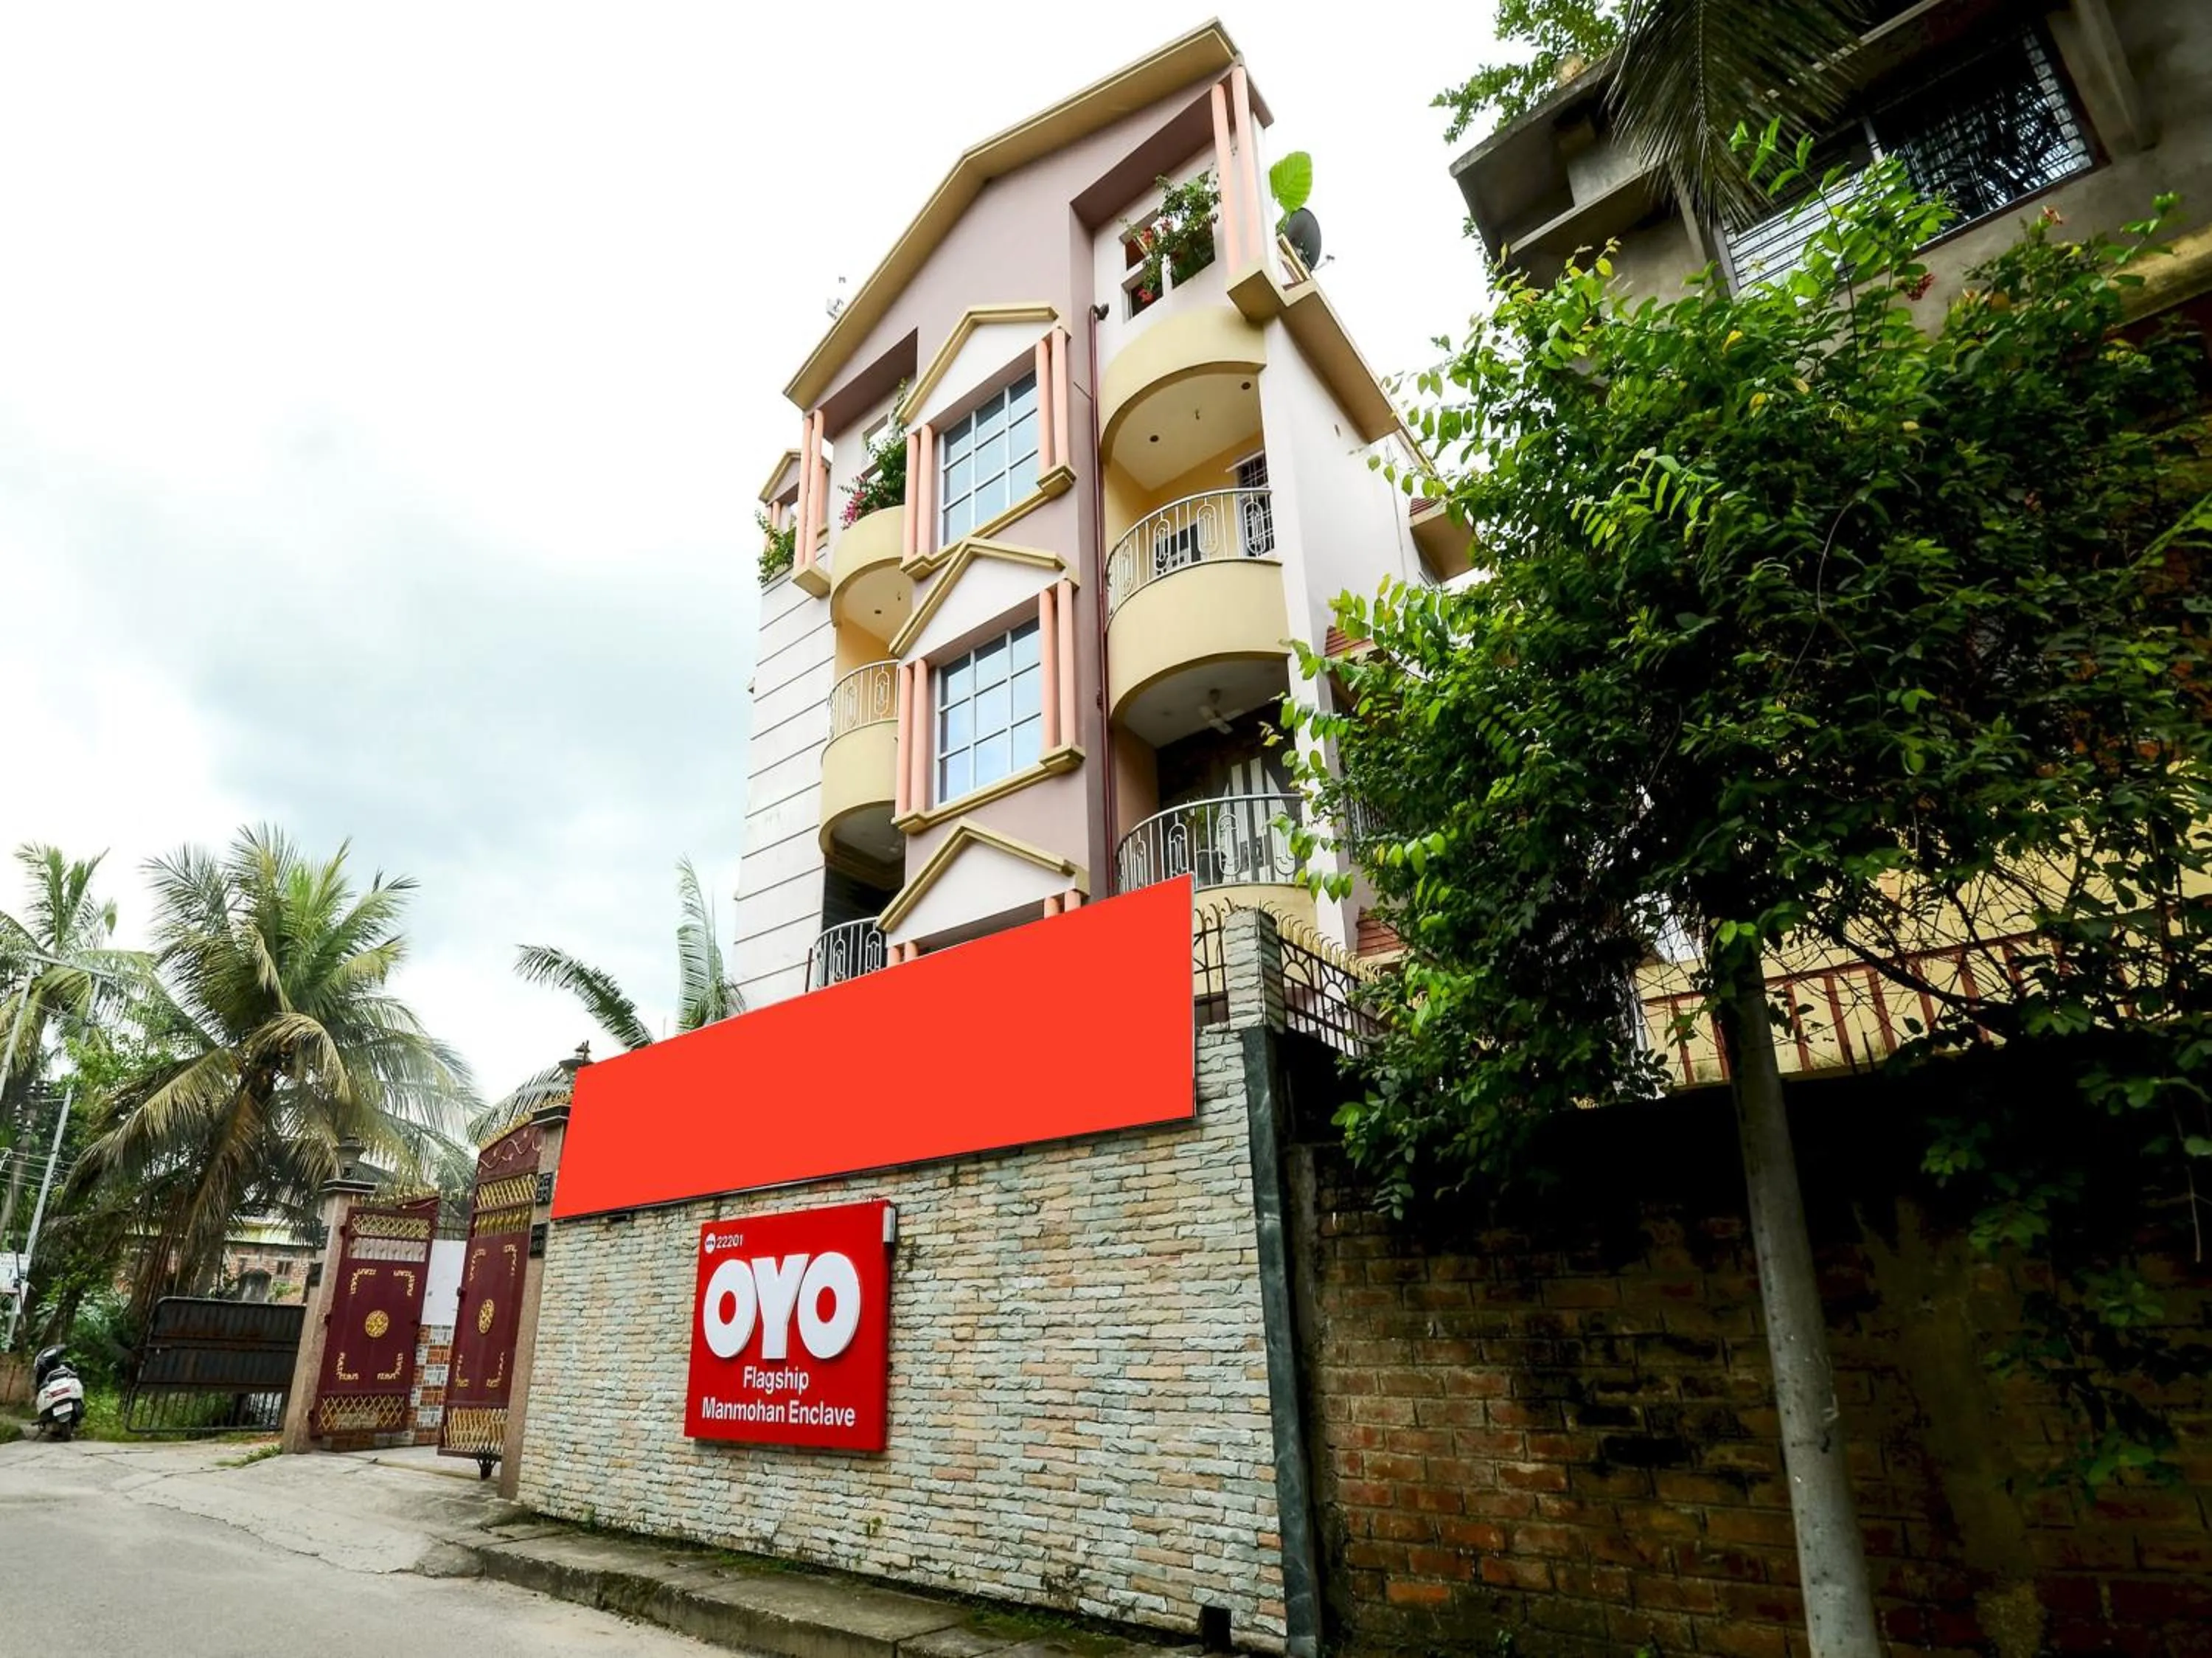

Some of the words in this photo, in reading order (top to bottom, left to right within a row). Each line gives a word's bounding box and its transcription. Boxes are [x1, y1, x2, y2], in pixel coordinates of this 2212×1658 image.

[716, 1234, 743, 1249] 22201
[703, 1251, 861, 1359] OYO
[743, 1365, 809, 1393] Flagship
[702, 1397, 785, 1423] Manmohan
[789, 1401, 856, 1427] Enclave
